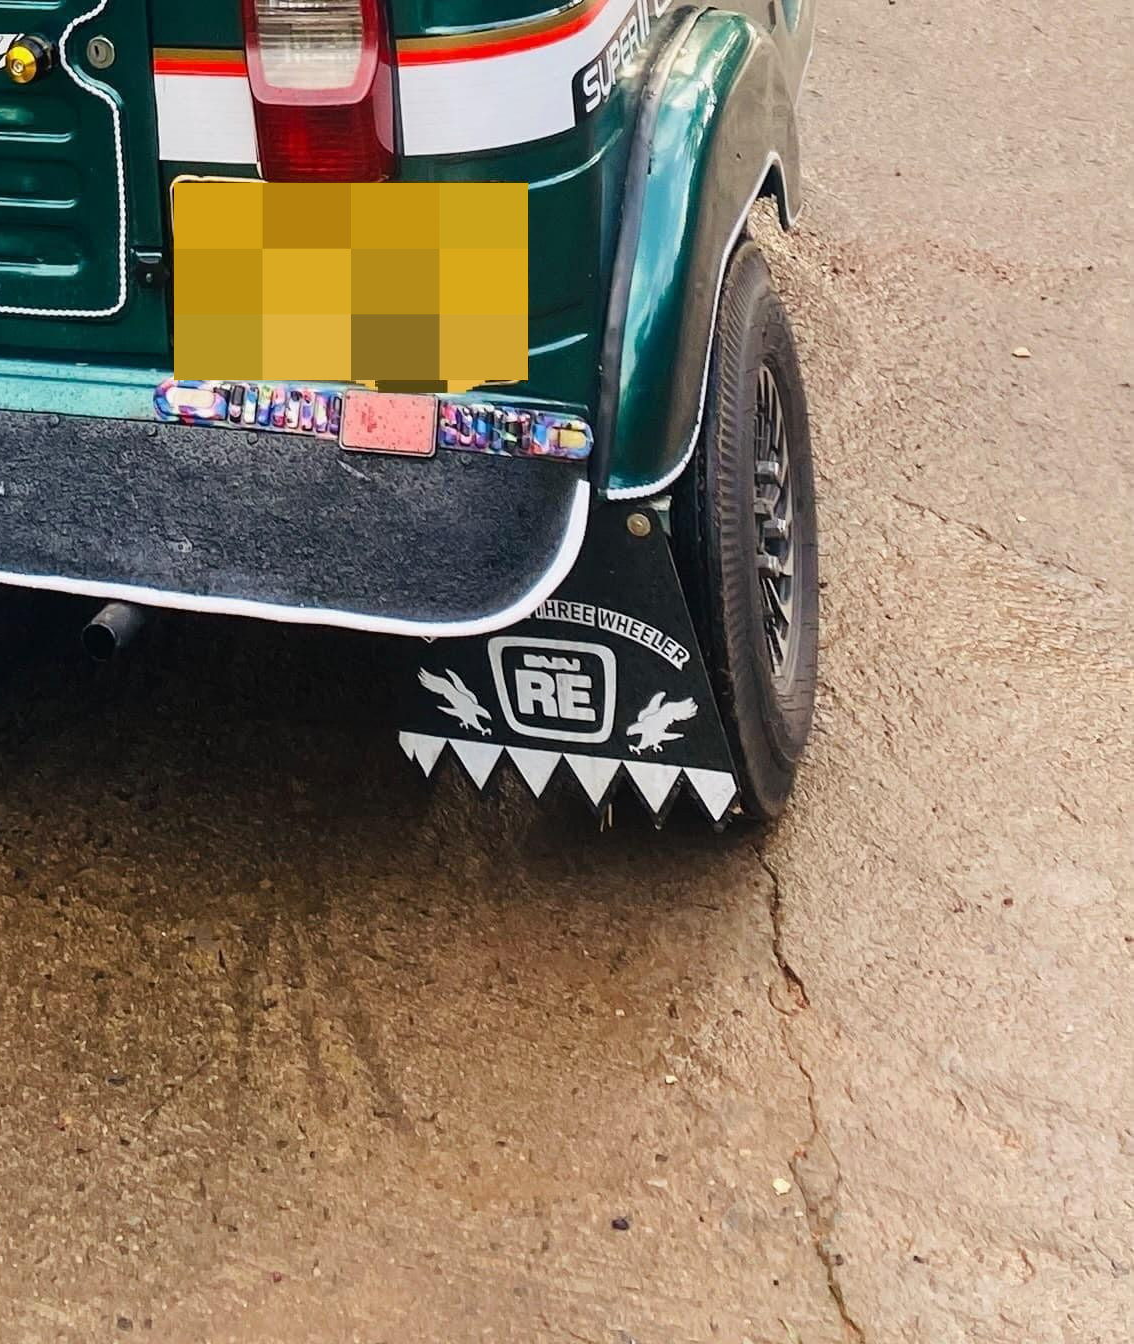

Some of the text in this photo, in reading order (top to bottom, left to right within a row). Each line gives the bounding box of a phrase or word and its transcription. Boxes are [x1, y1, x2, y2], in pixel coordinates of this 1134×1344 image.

[582, 15, 640, 113] SUPER
[599, 608, 689, 666] WHEELER
[515, 669, 596, 722] RE
